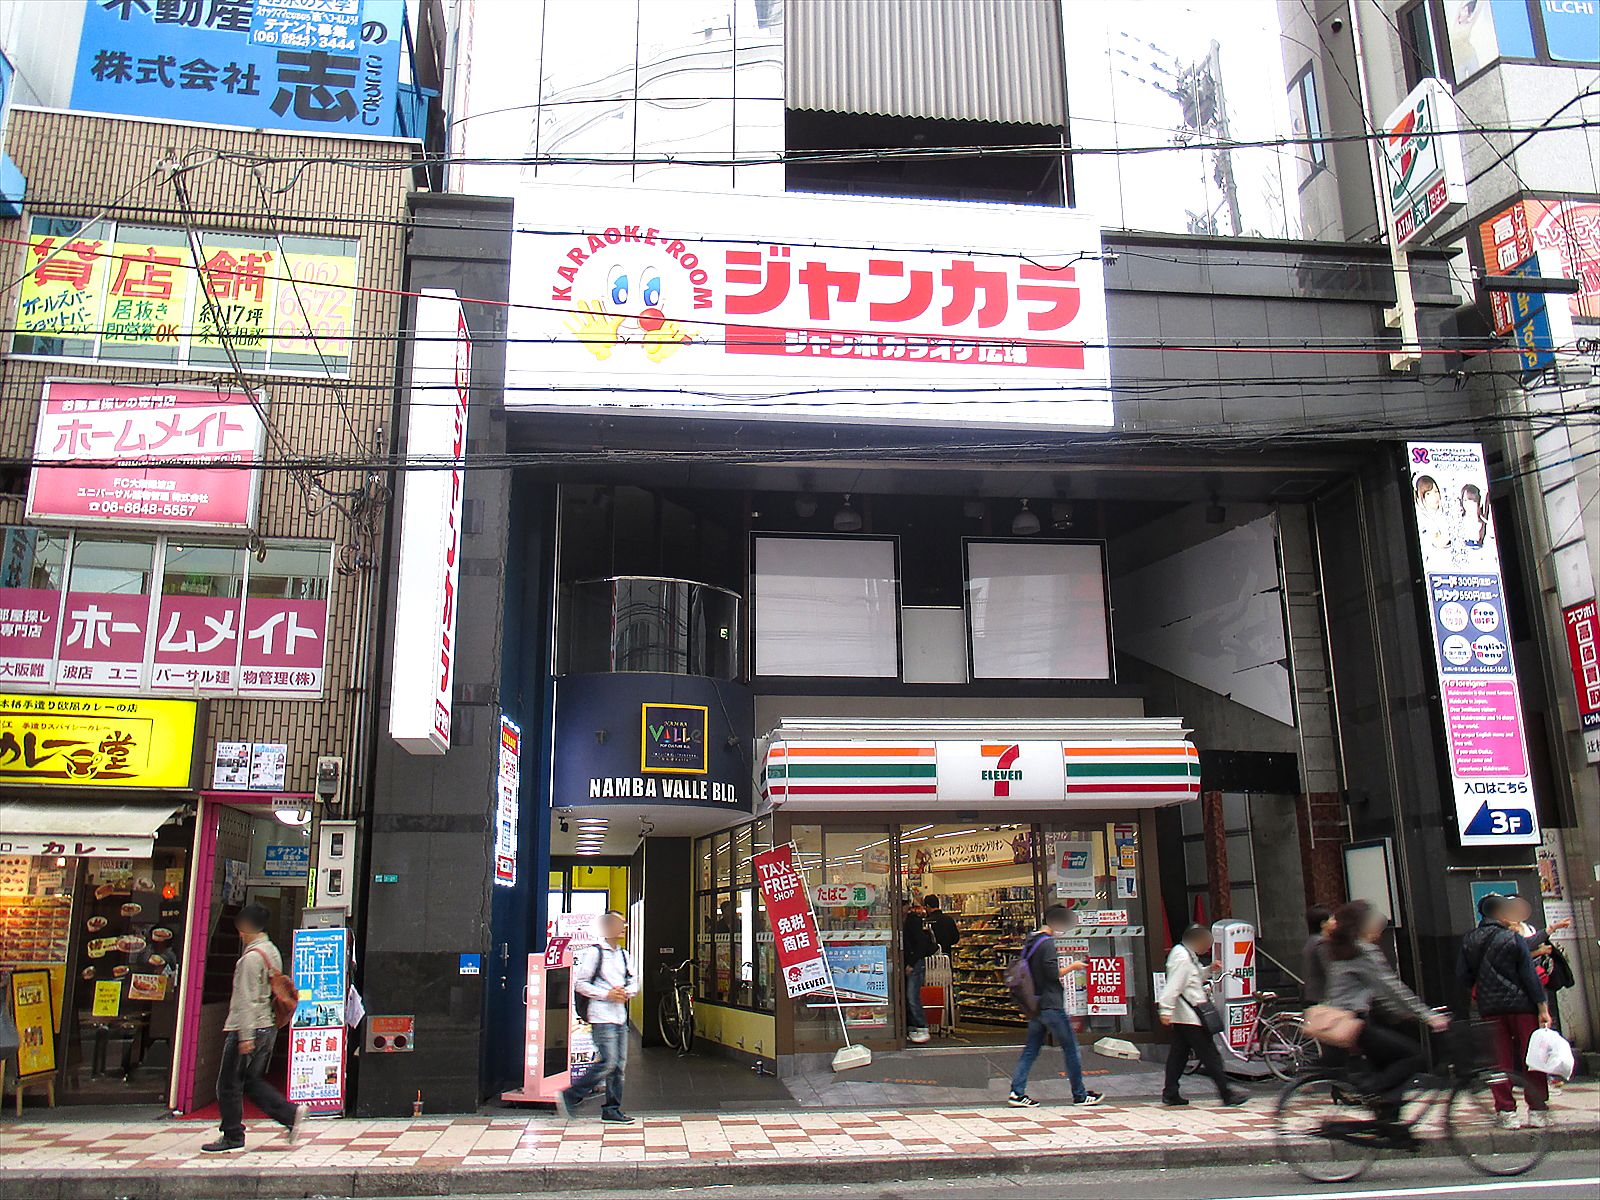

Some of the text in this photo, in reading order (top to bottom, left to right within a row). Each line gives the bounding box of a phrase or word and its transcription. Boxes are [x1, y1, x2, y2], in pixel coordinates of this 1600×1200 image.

[91, 50, 362, 122] 株式会社 志
[33, 237, 273, 302] 貸店舗
[725, 245, 1080, 332] ジャンカラ
[53, 411, 244, 455] ホームメイト
[66, 604, 318, 655] ホームメイト
[589, 778, 738, 804] NAMBA VALLE BLD.
[1463, 782, 1528, 795] 入口はこちら
[1490, 811, 1521, 833] 3F
[41, 841, 130, 855] カレー
[764, 875, 799, 896] FREE
[773, 890, 795, 902] SHOP
[817, 887, 847, 901] たばこ
[777, 913, 806, 935] 免税
[781, 932, 811, 953] 商店
[1090, 958, 1120, 972] TAX-
[1090, 972, 1121, 985] FREE
[1097, 985, 1116, 993] SHOP
